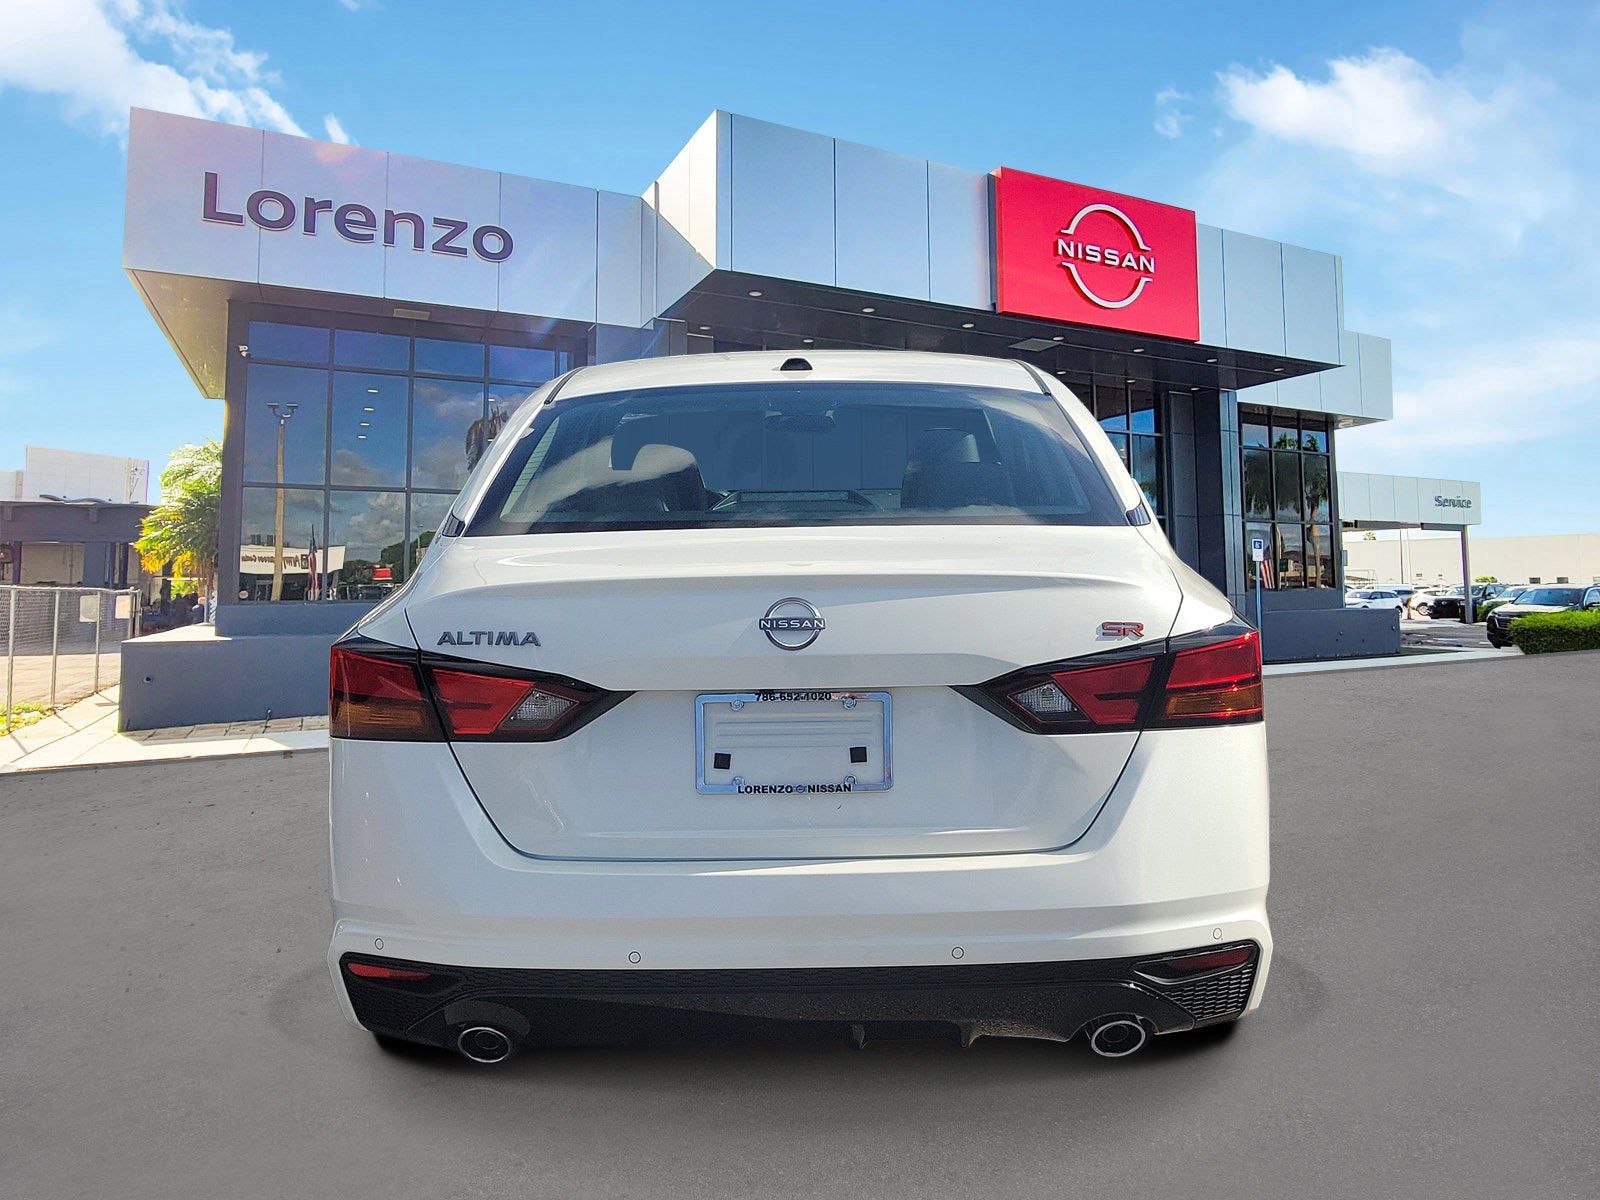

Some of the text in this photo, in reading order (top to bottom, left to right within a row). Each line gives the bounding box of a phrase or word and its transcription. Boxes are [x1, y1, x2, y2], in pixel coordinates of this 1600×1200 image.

[202, 171, 514, 262] Lorenzo
[1057, 238, 1155, 273] NISSAN
[1434, 495, 1472, 508] Service
[760, 619, 825, 629] NISSAN
[1101, 621, 1145, 637] SR
[437, 631, 541, 646] ALTIMA
[755, 692, 832, 701] 786-652-1020
[737, 784, 852, 794] LORENZO NISSAN
